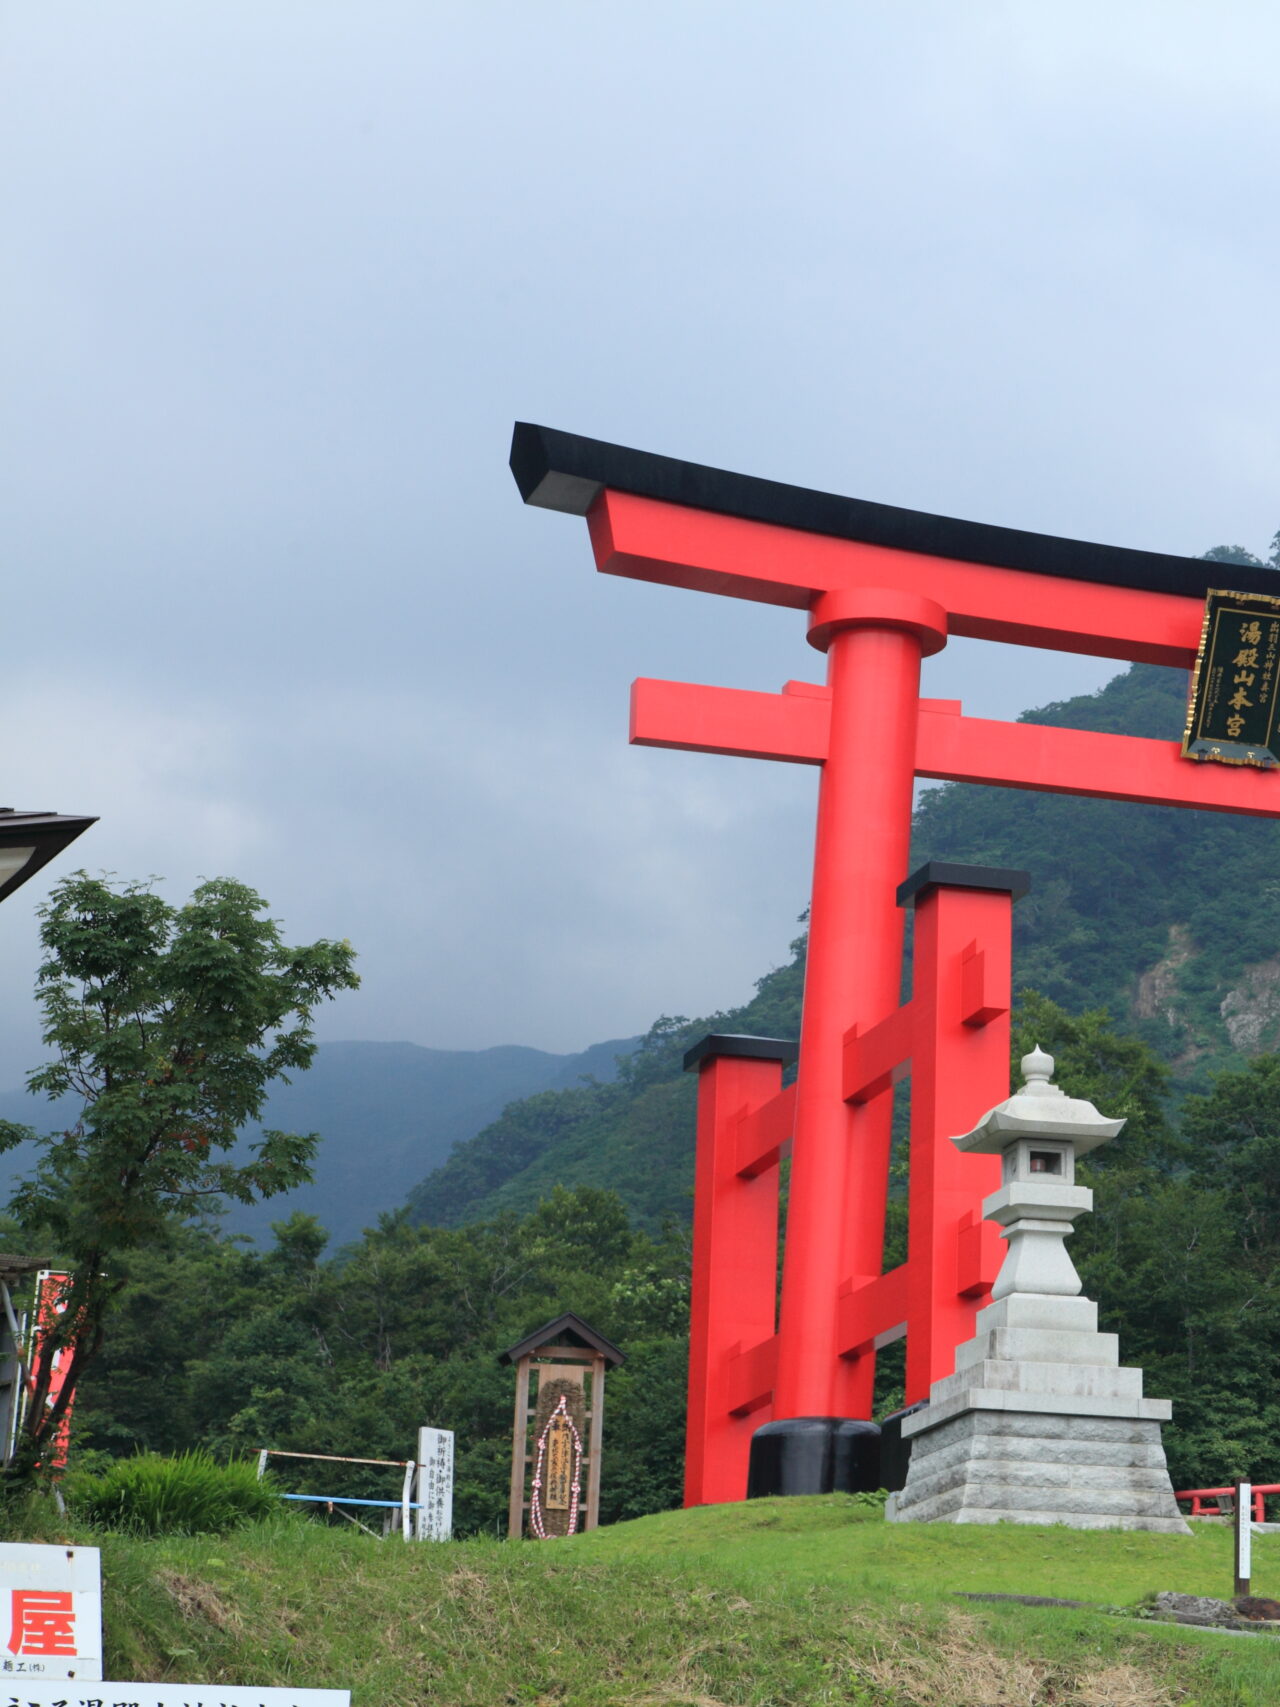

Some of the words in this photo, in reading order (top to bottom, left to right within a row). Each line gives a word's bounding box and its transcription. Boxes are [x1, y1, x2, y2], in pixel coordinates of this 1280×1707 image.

[1226, 621, 1263, 737] 湯殿山本宮
[7, 1589, 77, 1656] 屋
